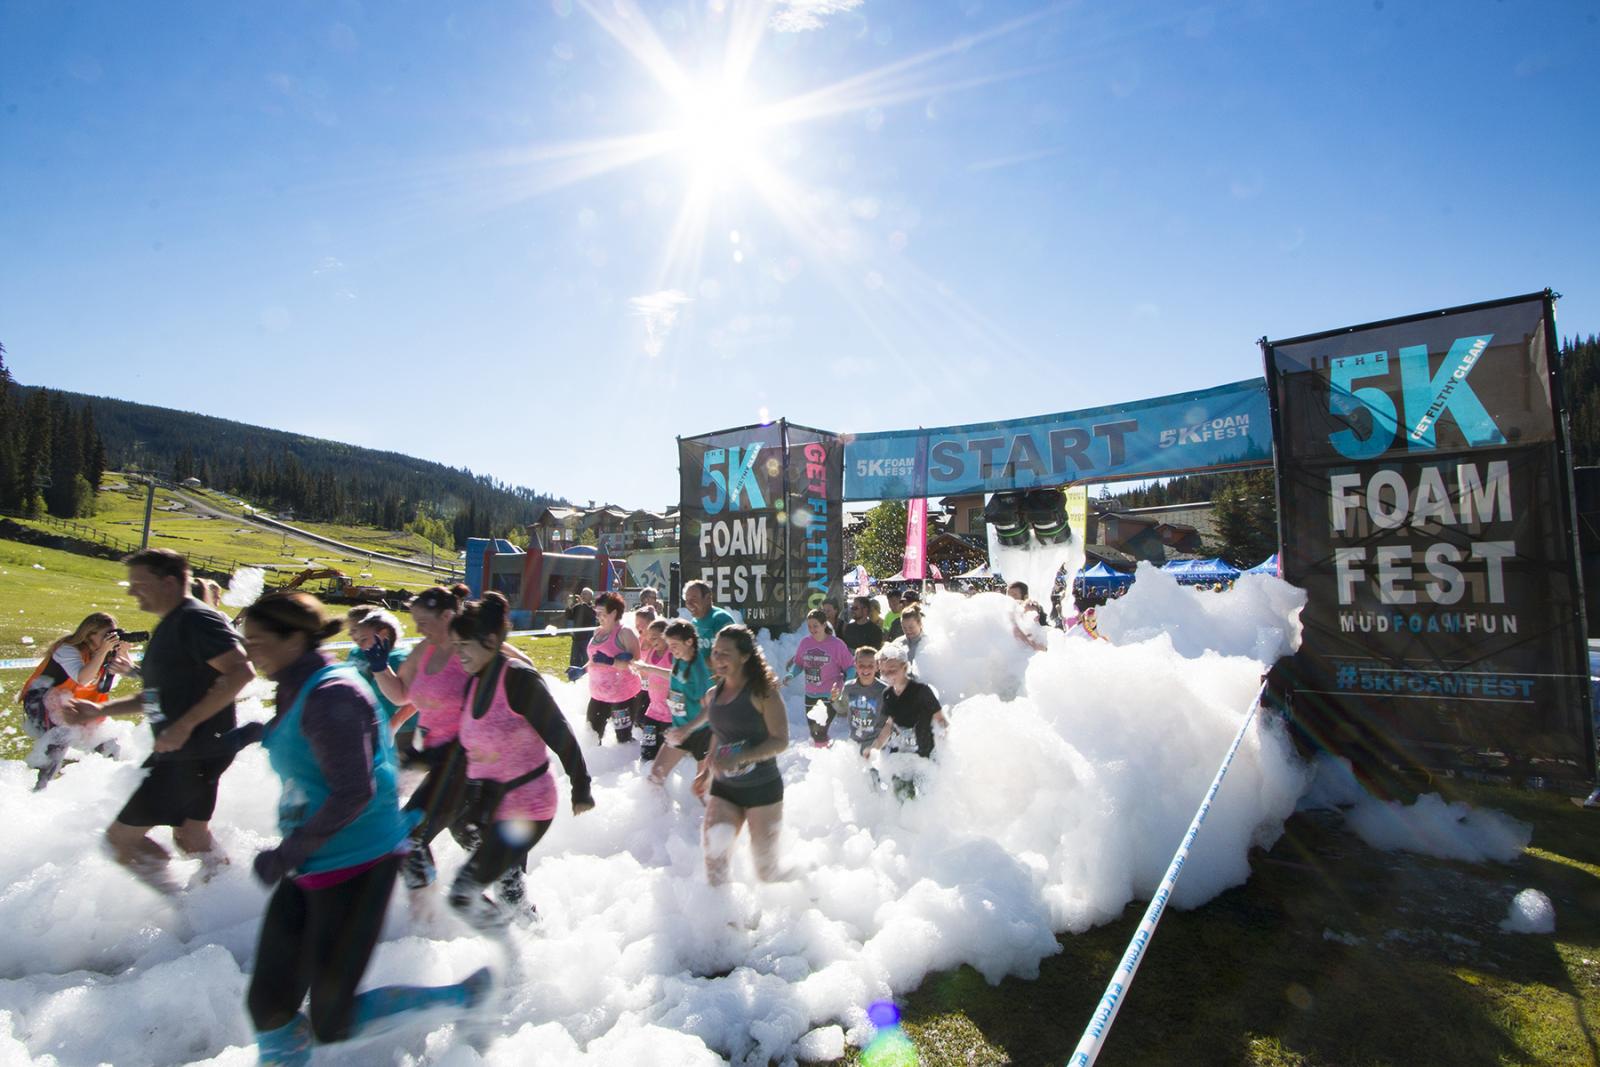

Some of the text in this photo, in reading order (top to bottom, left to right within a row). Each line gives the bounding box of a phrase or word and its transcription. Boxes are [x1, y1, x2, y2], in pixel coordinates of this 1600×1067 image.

[1336, 353, 1385, 368] THE
[1328, 334, 1507, 460] 5K
[1159, 424, 1201, 448] 5K
[1202, 414, 1249, 431] FOAM
[1202, 425, 1249, 442] FEST
[884, 457, 915, 467] FOAM
[929, 419, 1138, 482] START
[702, 442, 767, 514] 5K
[857, 459, 884, 477] 5K
[884, 467, 914, 476] FEST
[1330, 460, 1514, 532] FOAM
[699, 516, 768, 558] FOAM
[701, 564, 767, 604] FEST
[1335, 540, 1517, 606] FEST
[1336, 664, 1535, 698] #5KFOAMFEST
